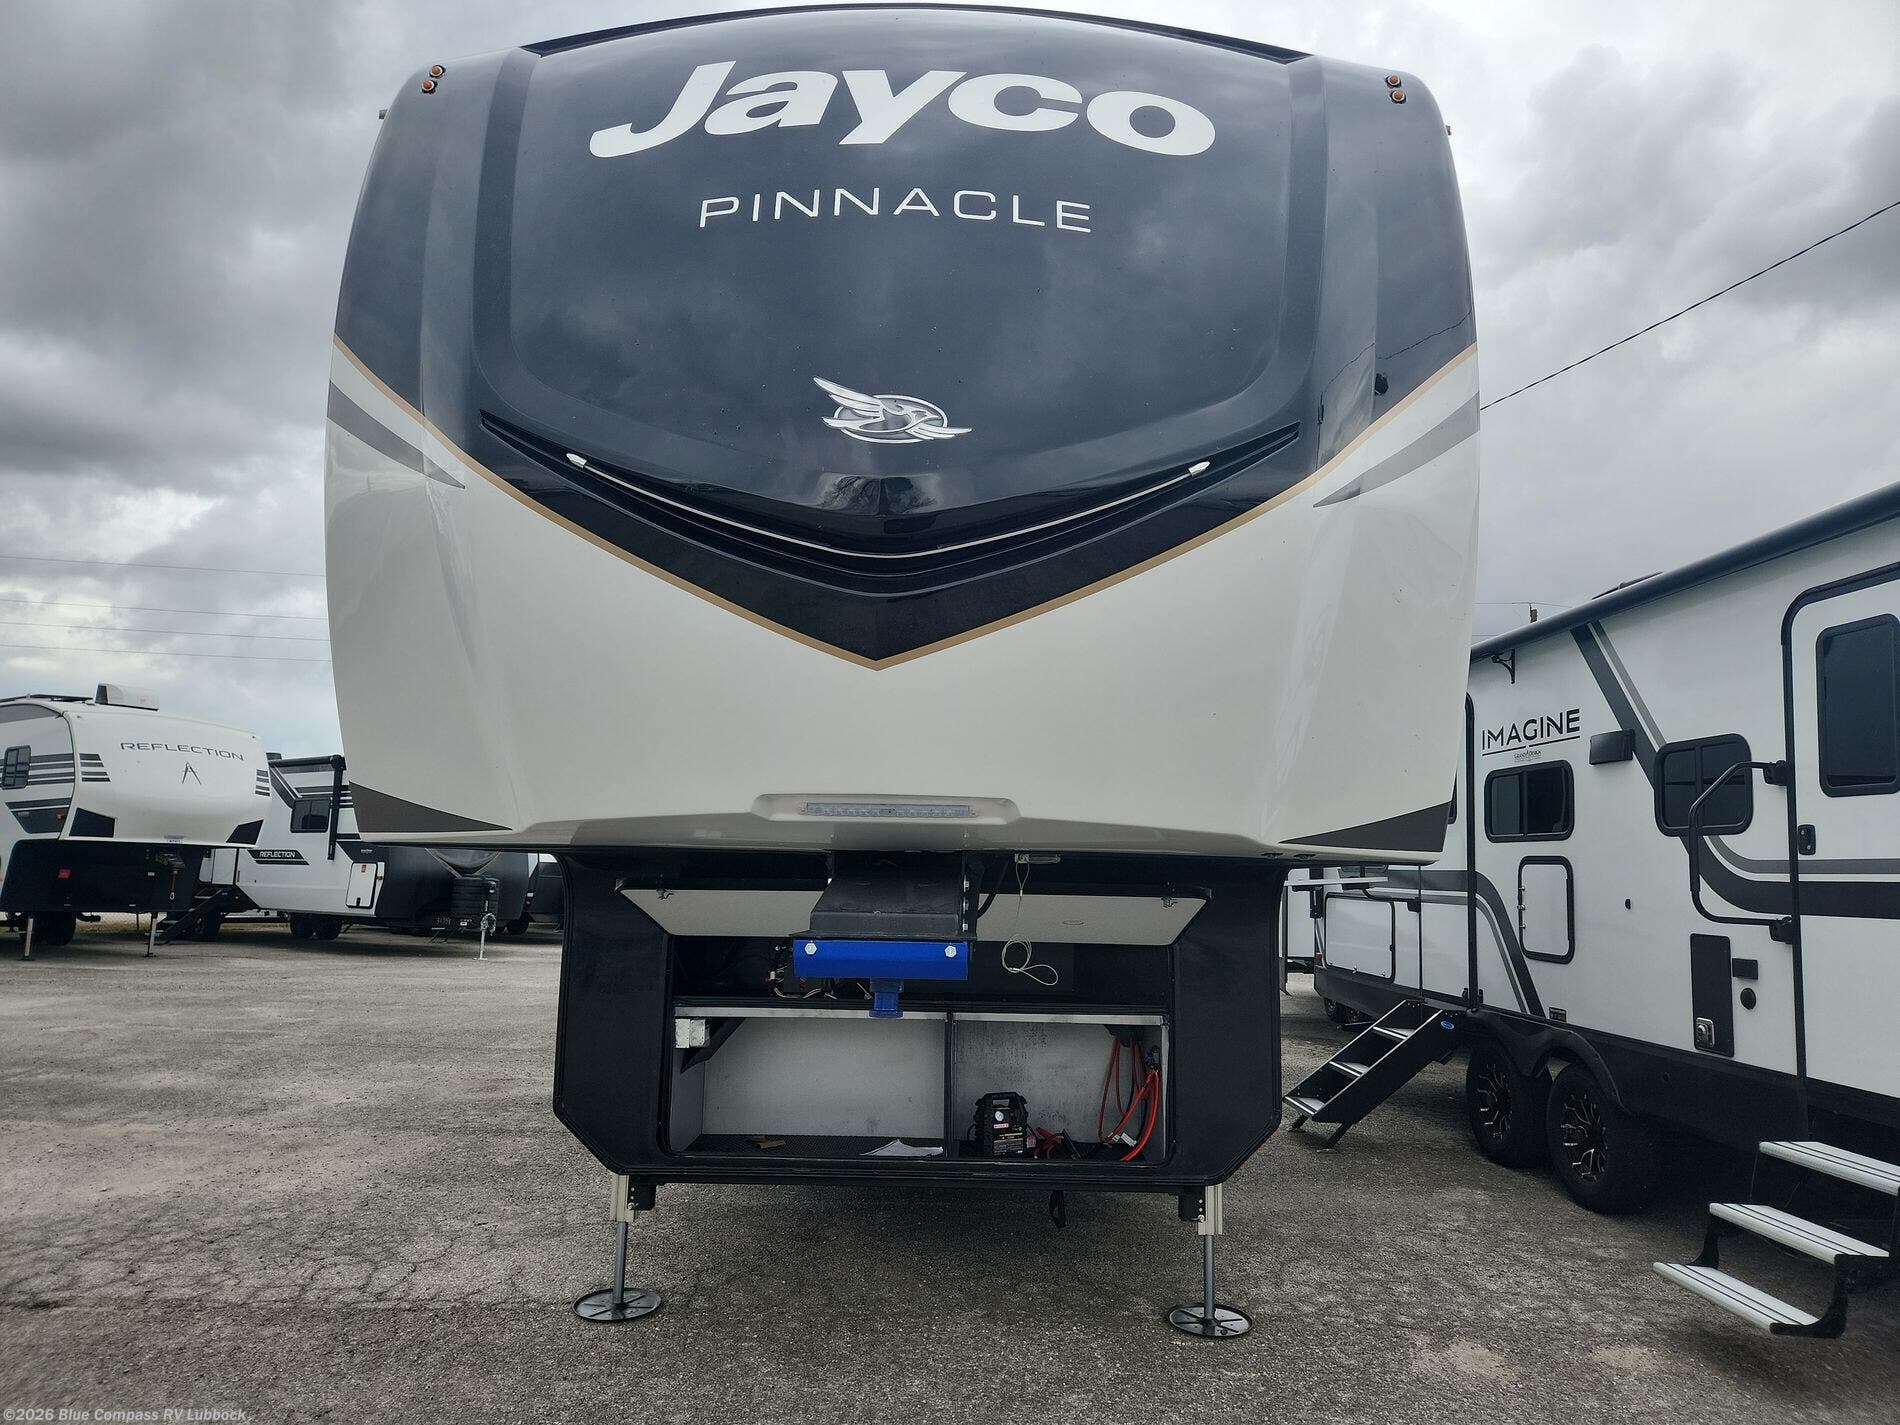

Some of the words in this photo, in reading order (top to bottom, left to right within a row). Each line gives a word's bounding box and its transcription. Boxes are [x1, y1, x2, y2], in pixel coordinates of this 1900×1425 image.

[589, 60, 1216, 158] Jayco
[699, 187, 1091, 233] PINNACLE
[1482, 708, 1580, 750] IMAGINE
[120, 742, 245, 761] REFLECTION
